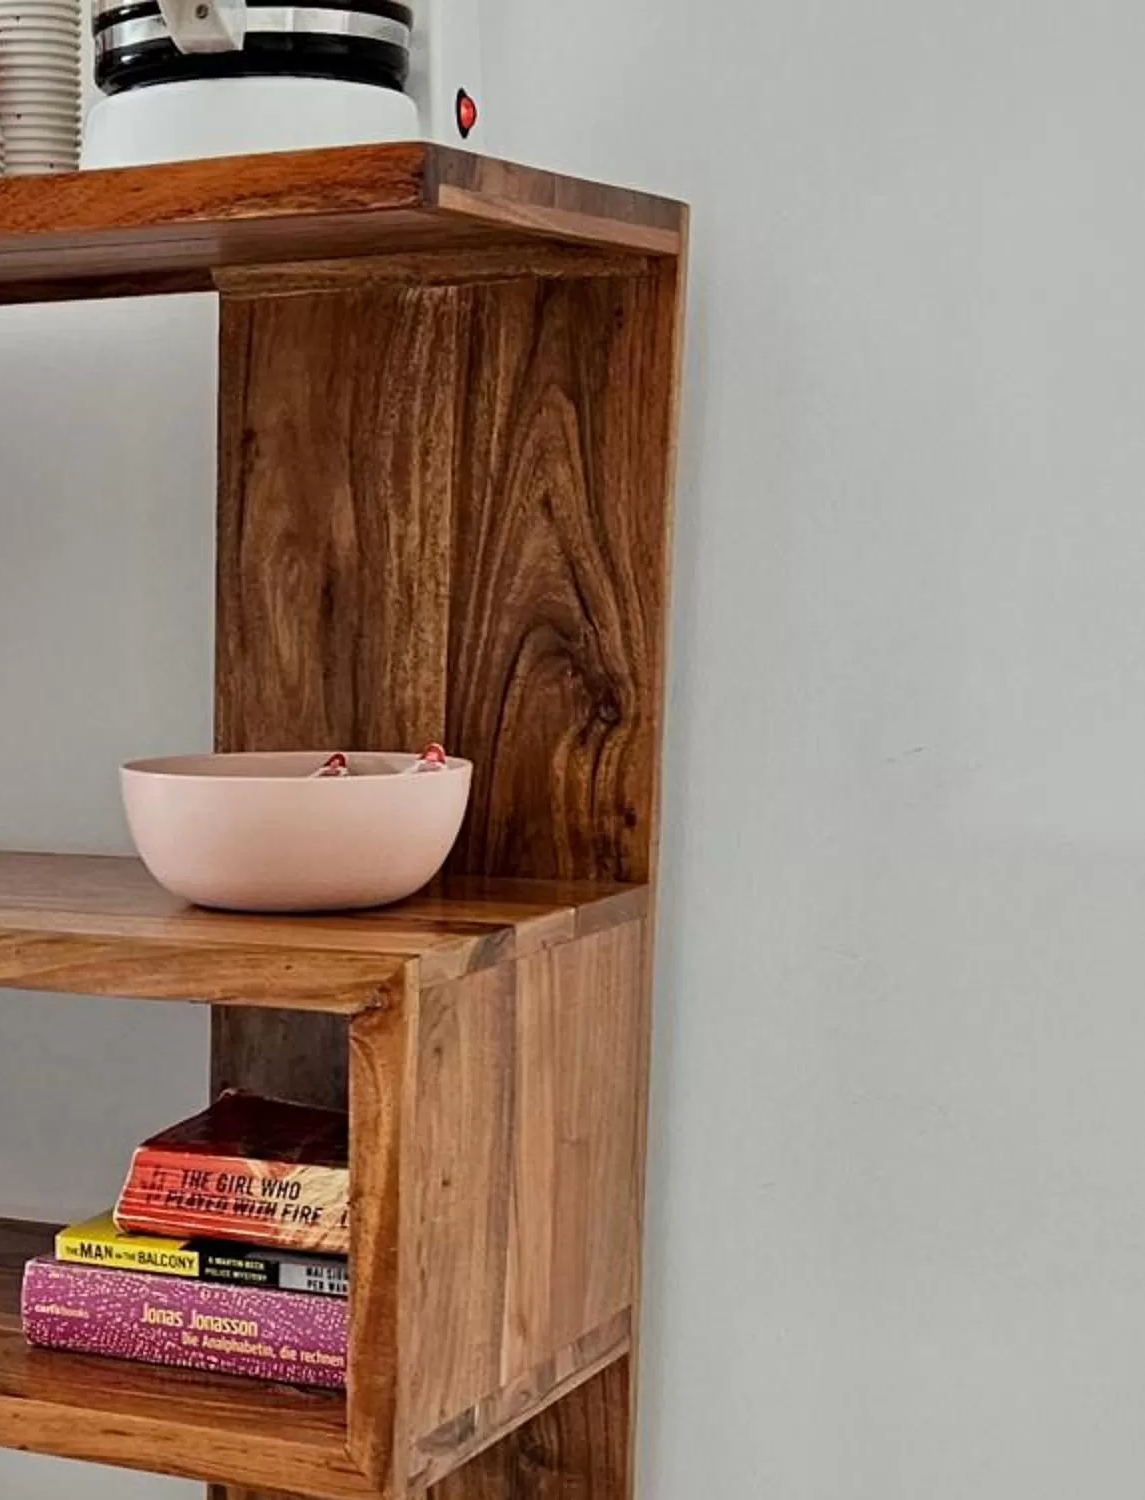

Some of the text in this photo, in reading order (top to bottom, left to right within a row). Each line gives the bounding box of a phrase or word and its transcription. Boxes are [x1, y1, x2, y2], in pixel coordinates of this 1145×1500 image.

[181, 1168, 213, 1192] THE
[216, 1173, 253, 1197] GIRL
[260, 1177, 301, 1200] WHO
[234, 1197, 276, 1218] WITH
[281, 1201, 323, 1227] FIRE
[80, 1242, 114, 1261] MAN
[138, 1252, 195, 1269] BALCONY
[140, 1302, 259, 1337] Jonas Jonasson
[280, 1344, 298, 1362] die
